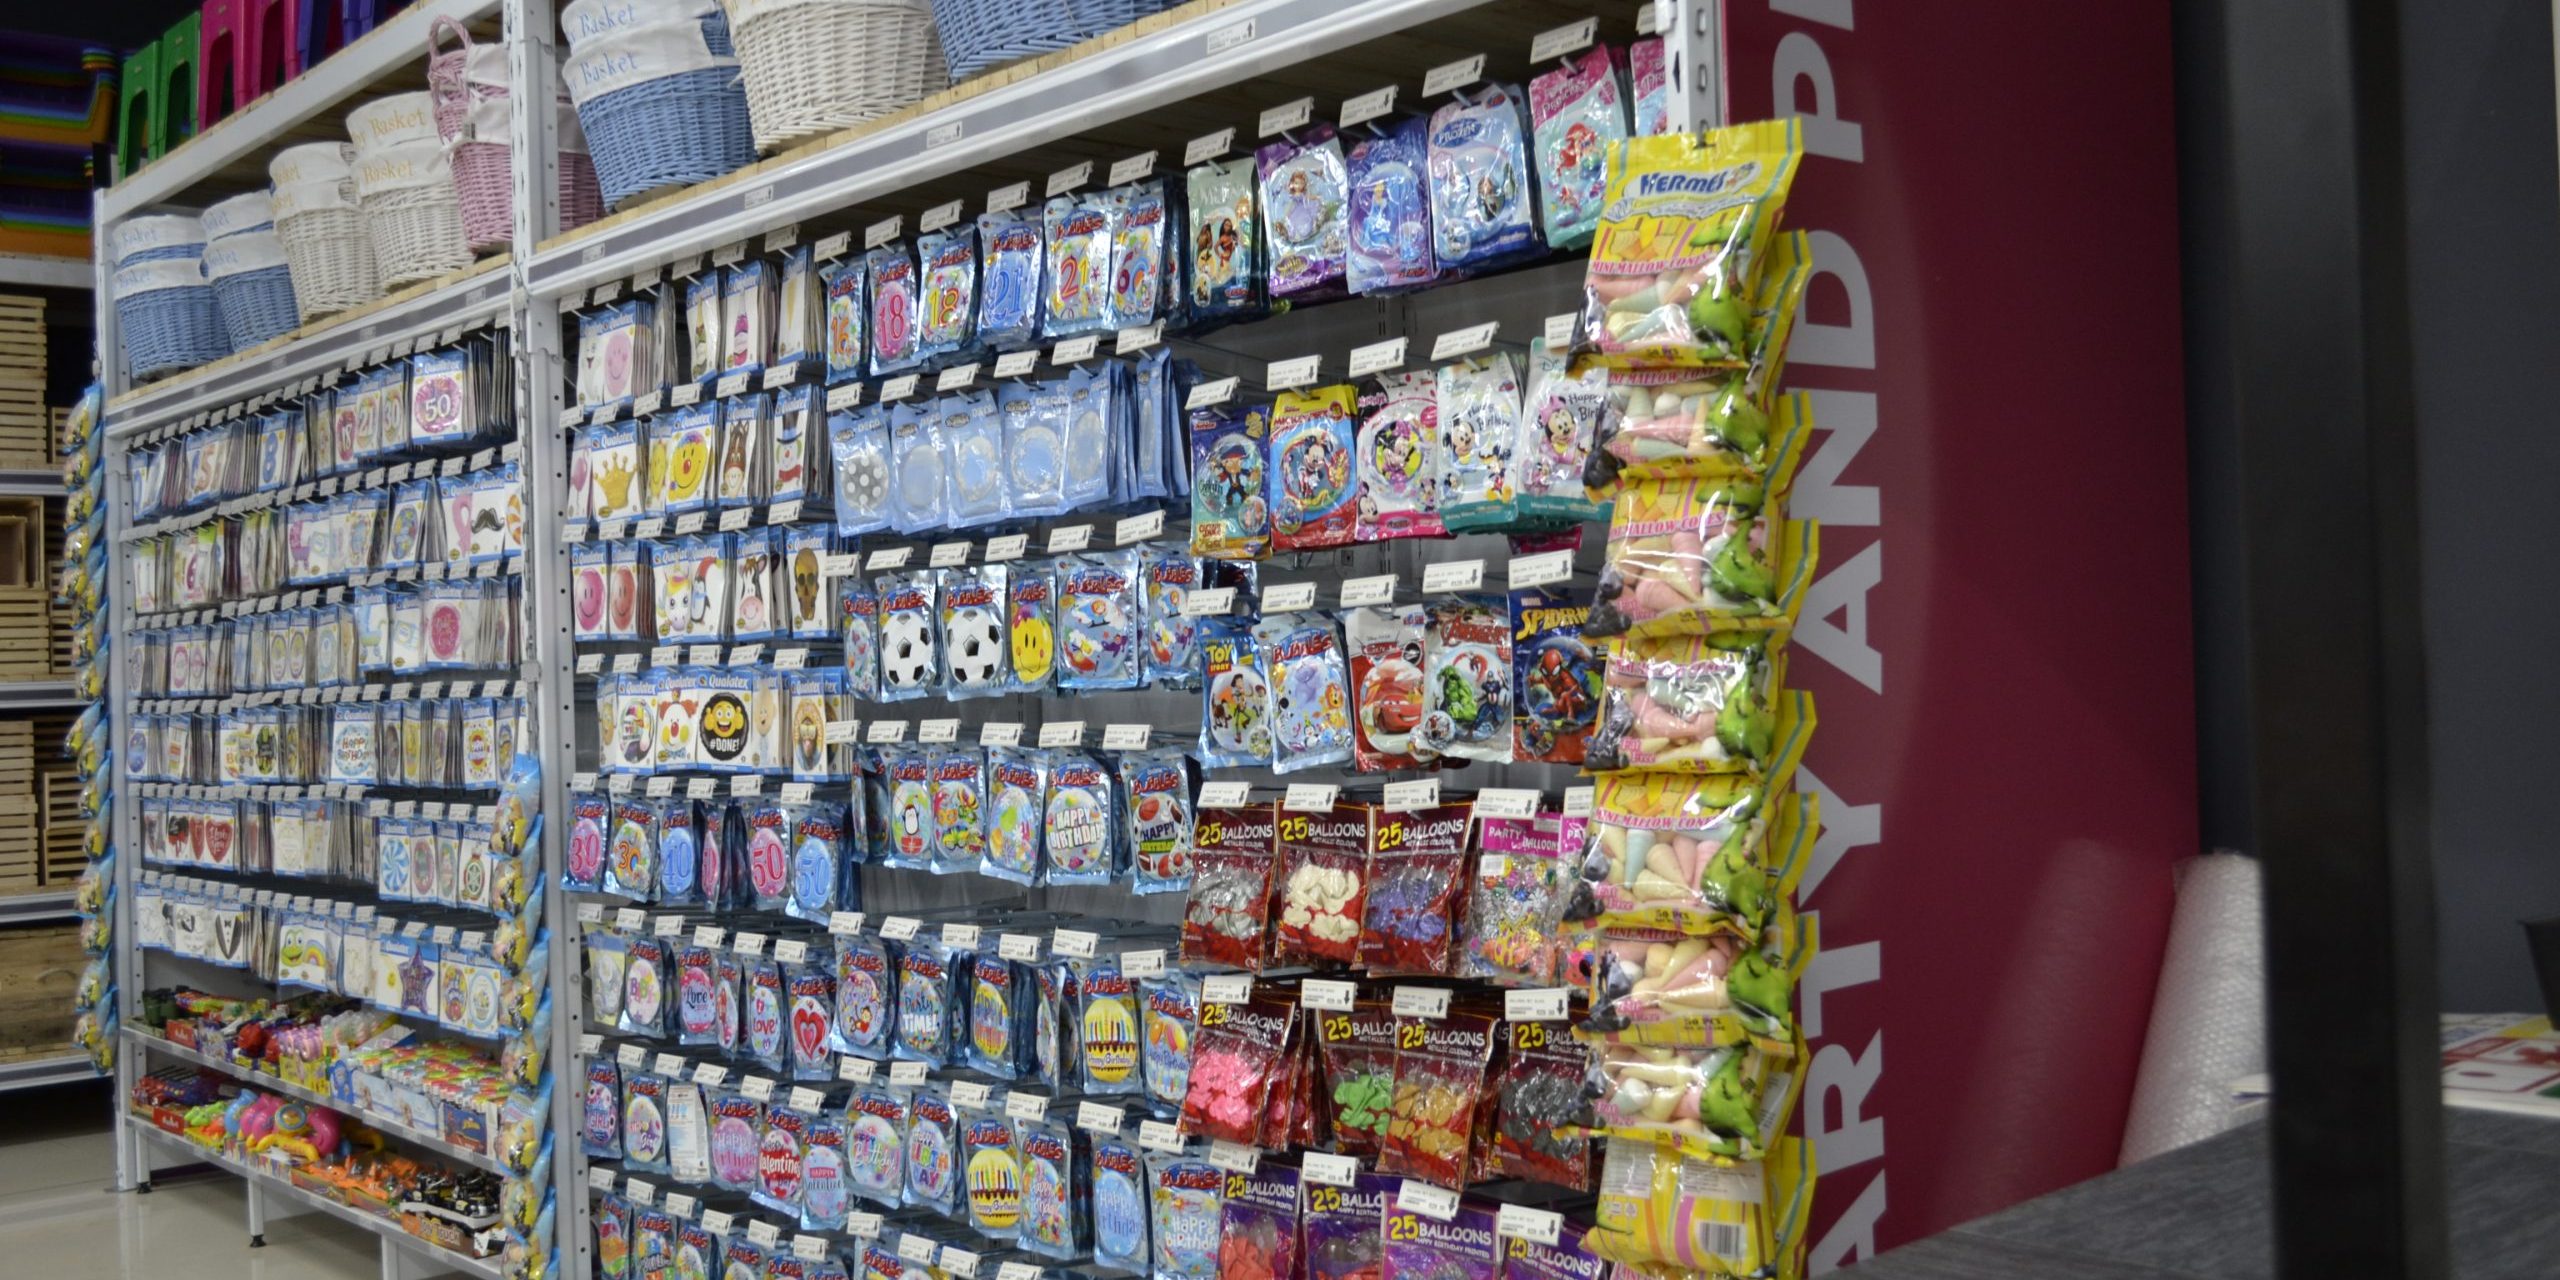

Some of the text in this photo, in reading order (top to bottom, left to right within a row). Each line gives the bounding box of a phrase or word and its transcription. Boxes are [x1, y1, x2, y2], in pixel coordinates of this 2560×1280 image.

[1763, 0, 1864, 163] P
[928, 288, 961, 331] 18
[425, 394, 451, 422] 50
[1785, 231, 1884, 697] AND
[1206, 644, 1233, 663] TOY
[709, 676, 750, 690] Qualatex
[709, 737, 740, 753] #DONE!
[1056, 808, 1091, 830] HAPPY
[1142, 821, 1175, 841] HAPPY
[1280, 816, 1367, 842] 25 BALLOONS
[1488, 826, 1521, 838] PARTY
[1199, 822, 1274, 846] 25 BALLOONS
[1377, 819, 1465, 850] 25 BALLOONS
[571, 833, 601, 874] 30
[752, 843, 784, 888] 50
[1203, 1004, 1285, 1032] 25 BALLOONS
[1325, 1016, 1352, 1041] 25
[1402, 1023, 1486, 1049] 25 BALLOONS
[1517, 1022, 1544, 1049] 25
[1226, 1174, 1296, 1199] 25 BALLOONS
[1312, 1187, 1341, 1212] 25
[1389, 1215, 1492, 1246] 25 BALLOONS
[1509, 1236, 1592, 1276] 25 BALLOONS
